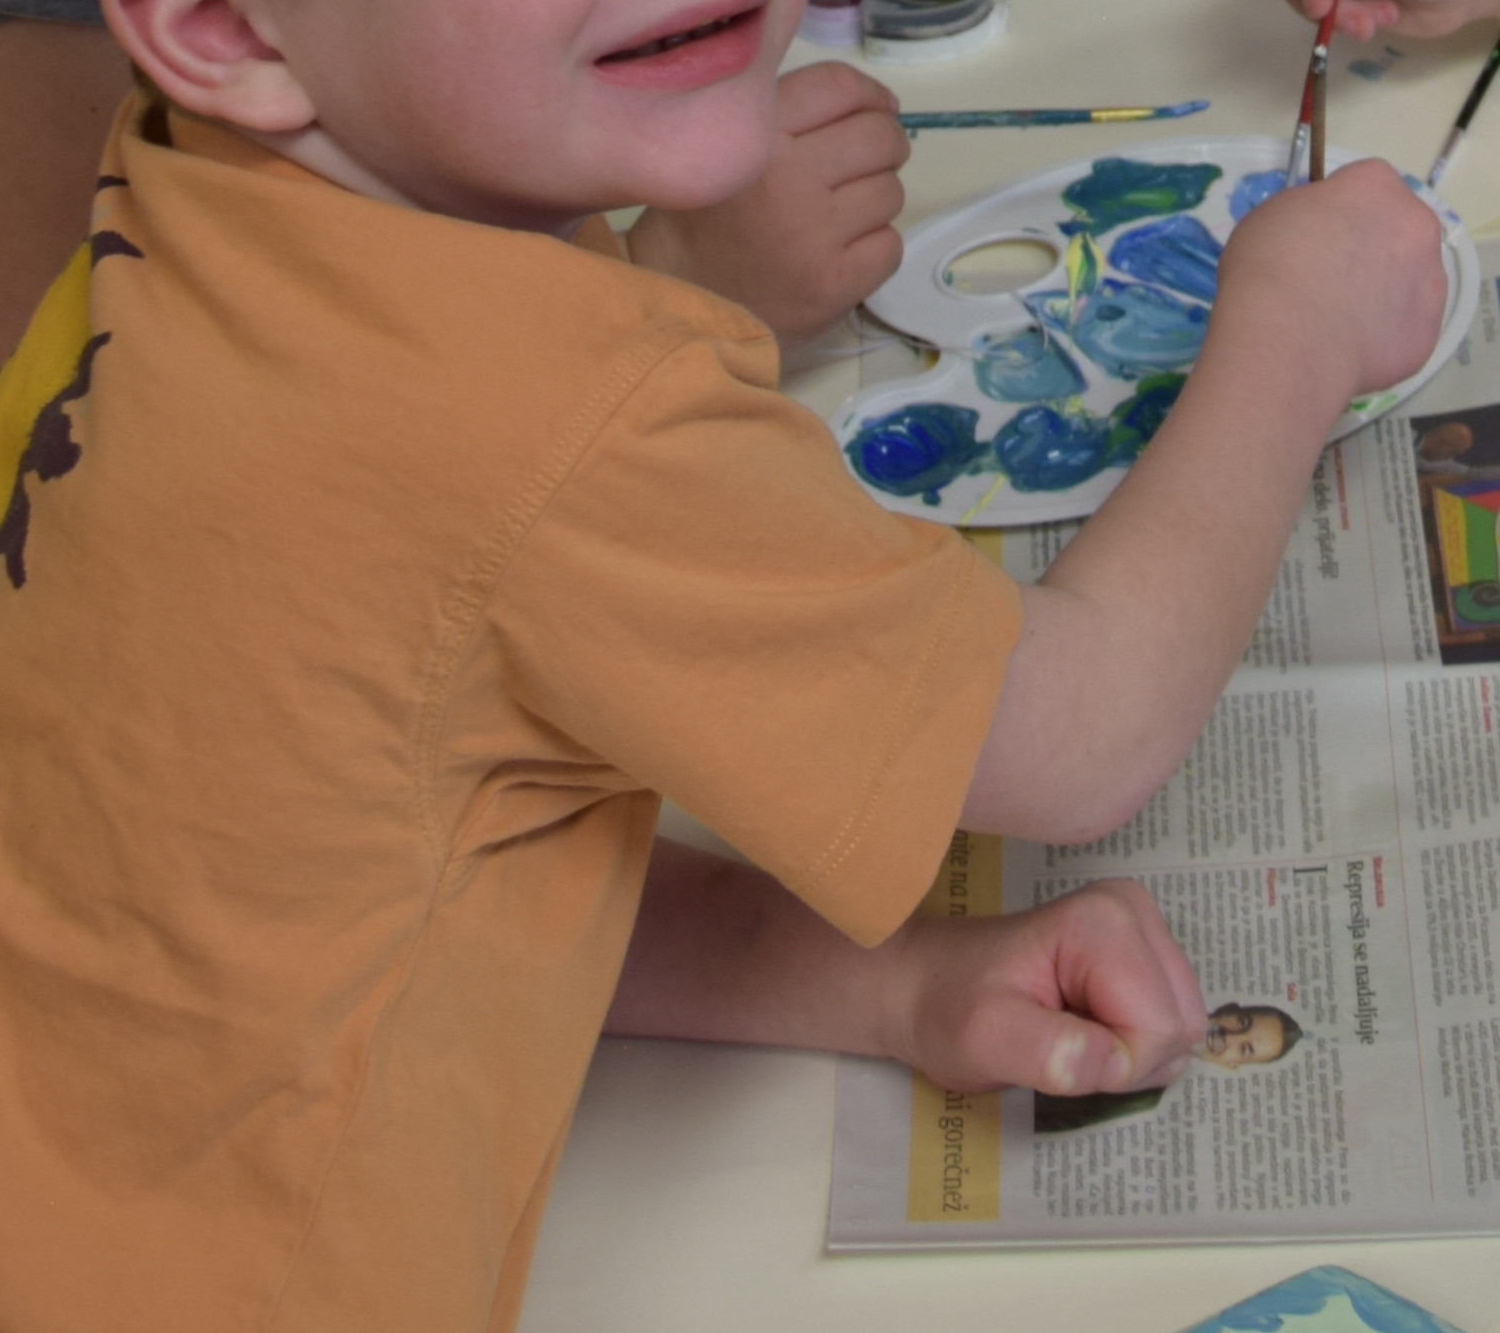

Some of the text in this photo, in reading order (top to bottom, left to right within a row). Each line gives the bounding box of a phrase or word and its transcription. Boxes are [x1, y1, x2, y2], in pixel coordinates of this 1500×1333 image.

[948, 871, 966, 895] na
[1344, 861, 1378, 1046] Represija se nadaljuje
[939, 1116, 969, 1212] gorečnež
